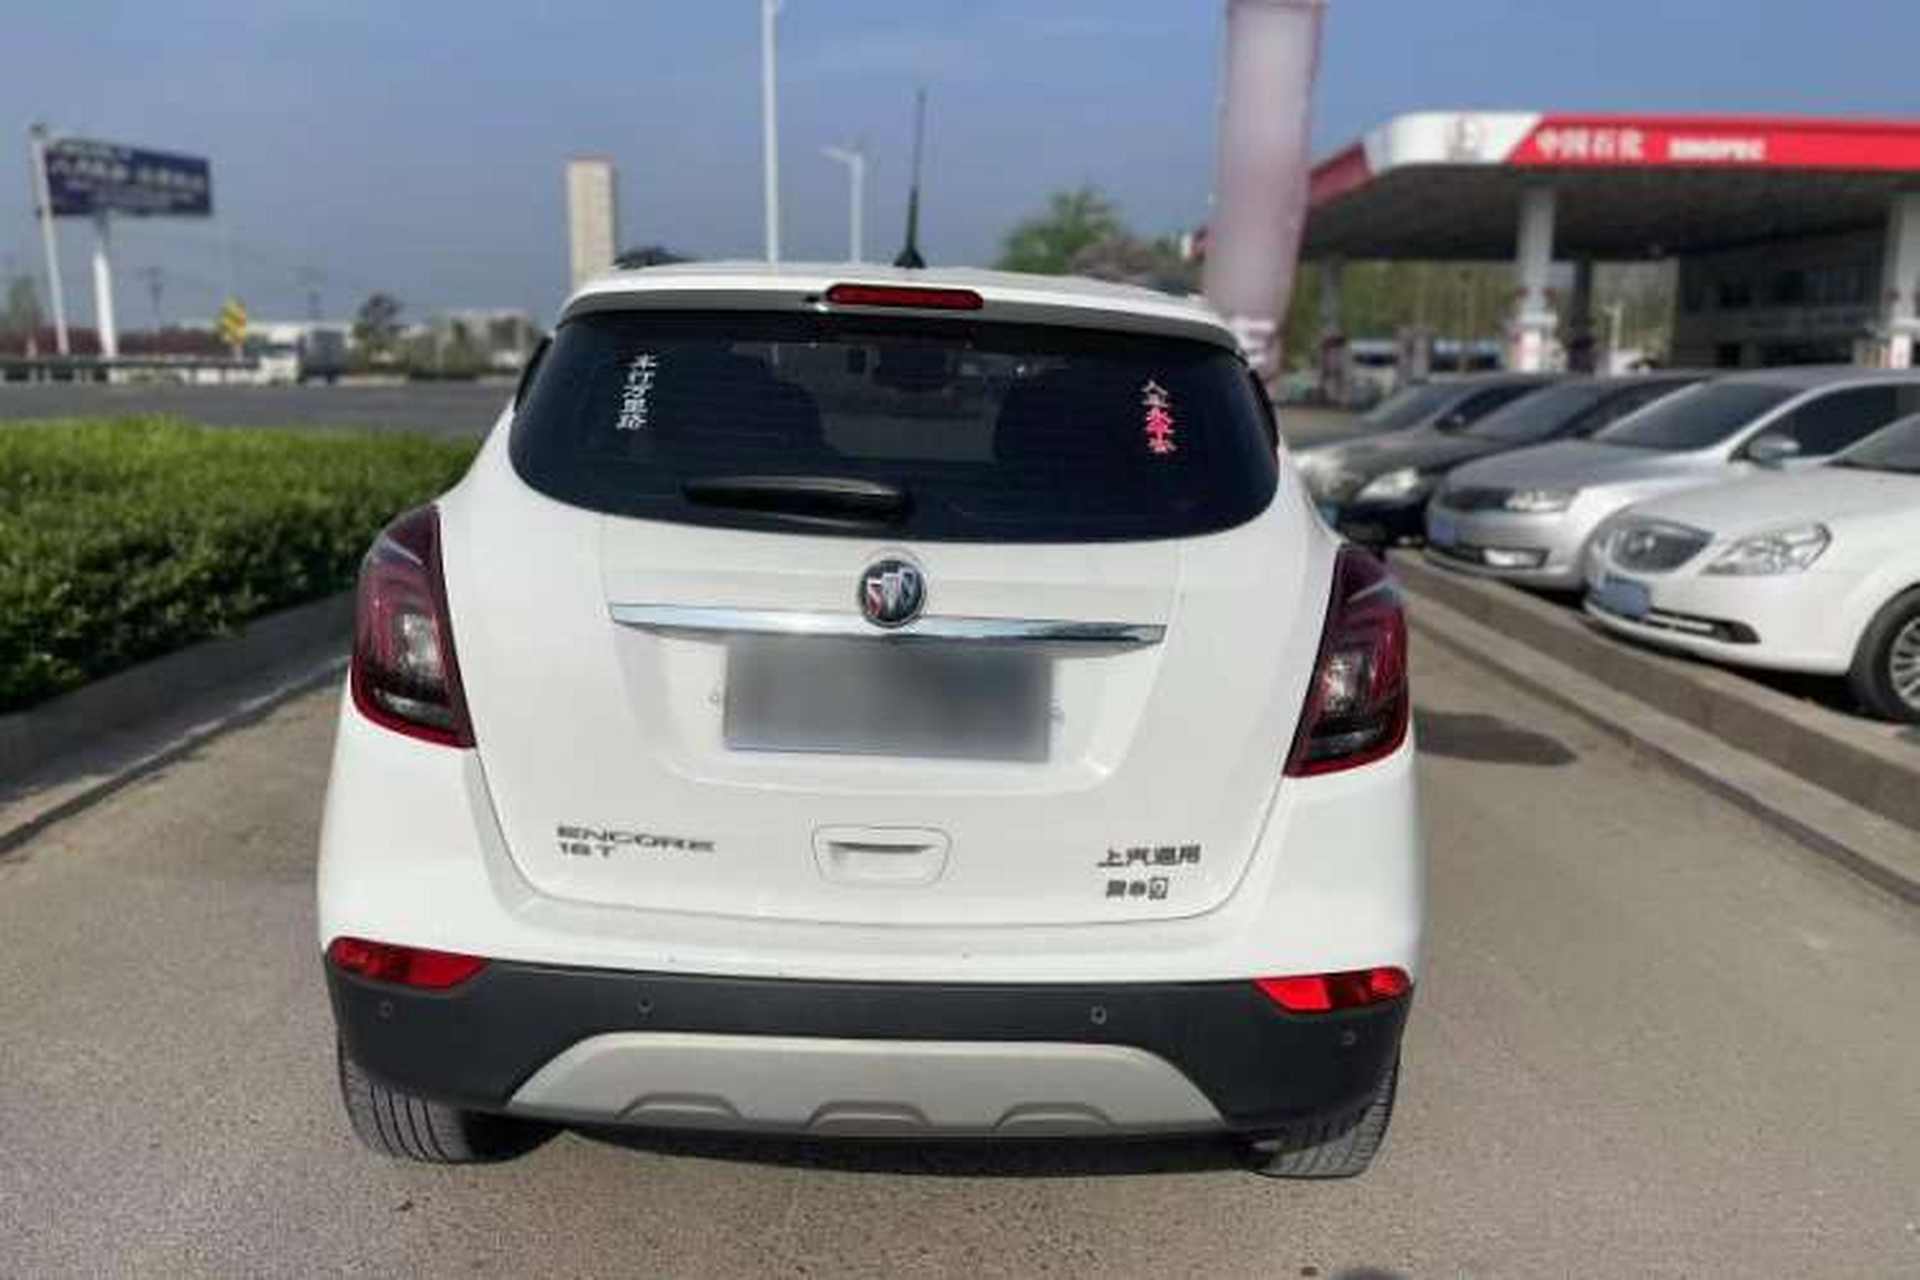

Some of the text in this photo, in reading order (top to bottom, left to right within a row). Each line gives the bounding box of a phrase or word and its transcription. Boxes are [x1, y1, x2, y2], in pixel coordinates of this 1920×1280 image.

[1535, 128, 1644, 161] 中国石化
[556, 825, 715, 852] ENCORE
[1097, 844, 1201, 867] 上汽通用
